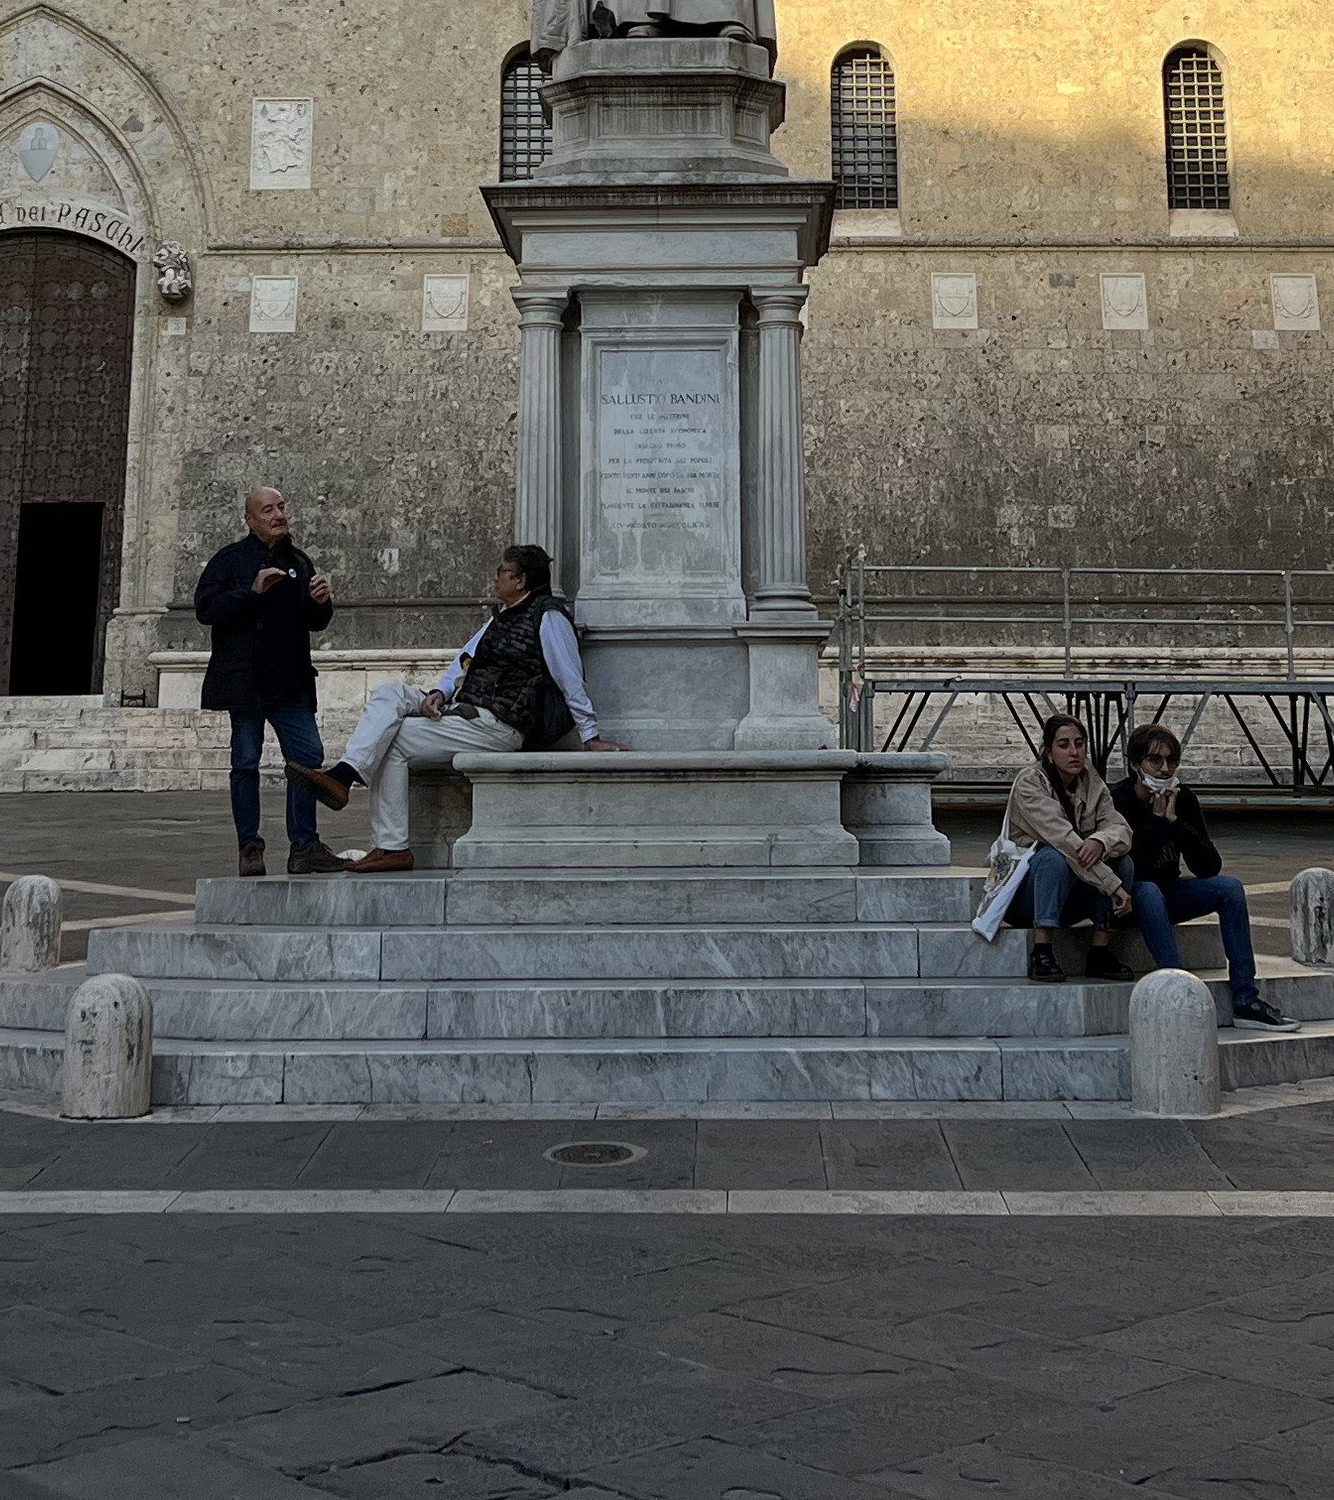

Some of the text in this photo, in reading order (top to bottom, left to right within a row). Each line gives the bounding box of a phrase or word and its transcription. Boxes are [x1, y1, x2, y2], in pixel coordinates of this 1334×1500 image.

[16, 205, 46, 222] DEI
[57, 202, 144, 253] PASCHI
[601, 393, 721, 405] SALLUSTIO BANDINI
